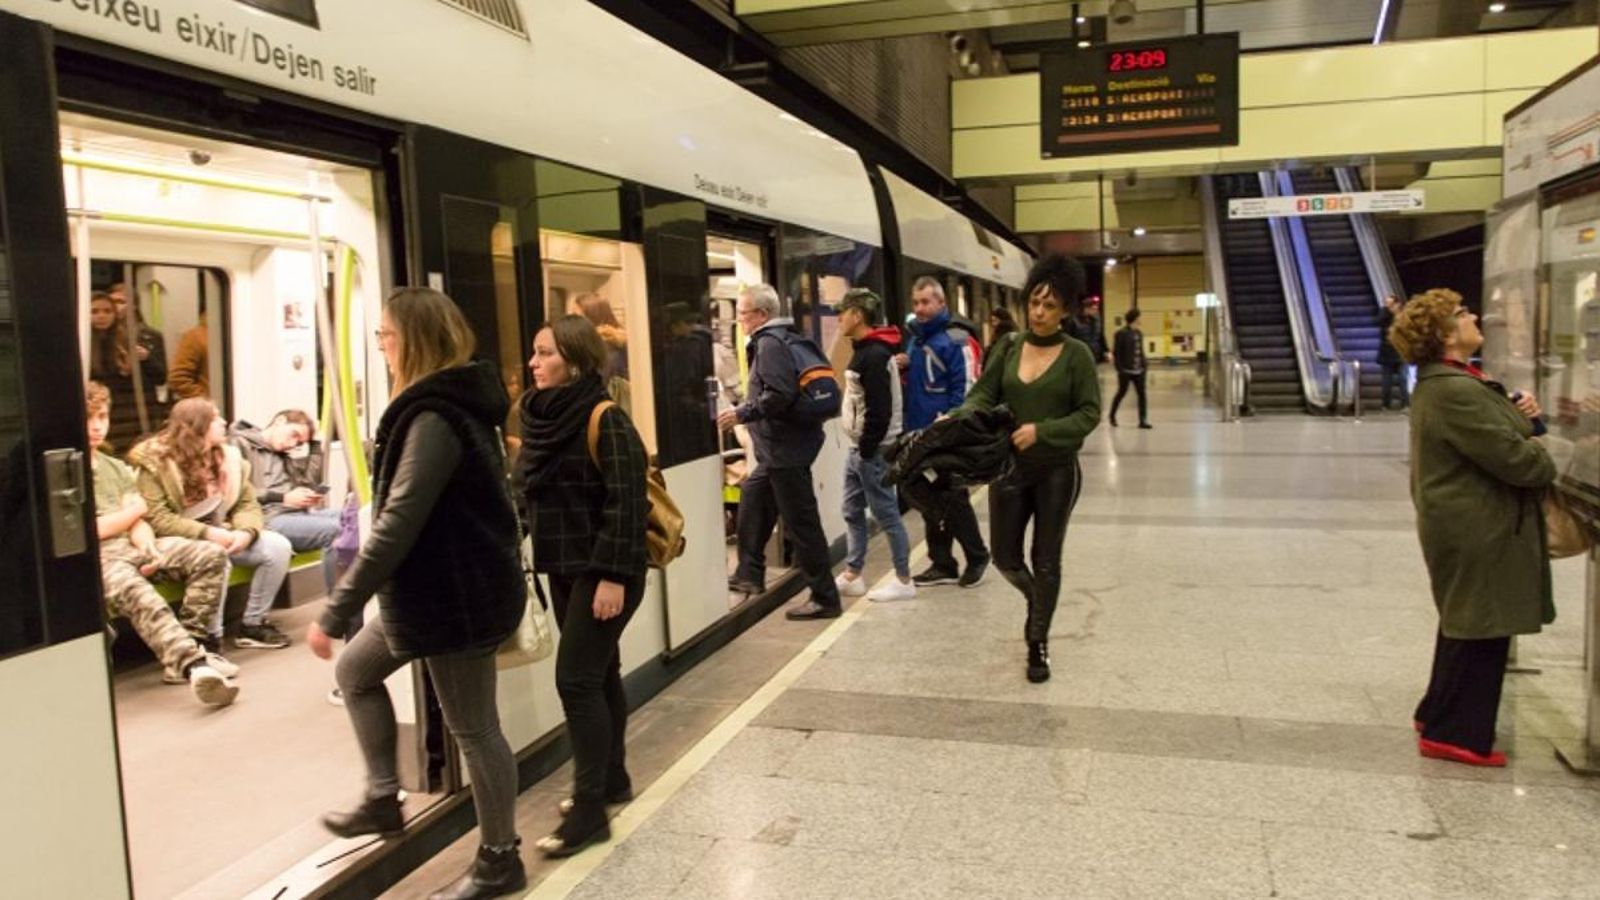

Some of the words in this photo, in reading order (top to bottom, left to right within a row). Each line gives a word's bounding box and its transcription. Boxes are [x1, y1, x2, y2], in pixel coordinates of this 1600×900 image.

[49, 0, 161, 33] xeu
[333, 65, 377, 96] salir
[1110, 51, 1166, 71] 23:09
